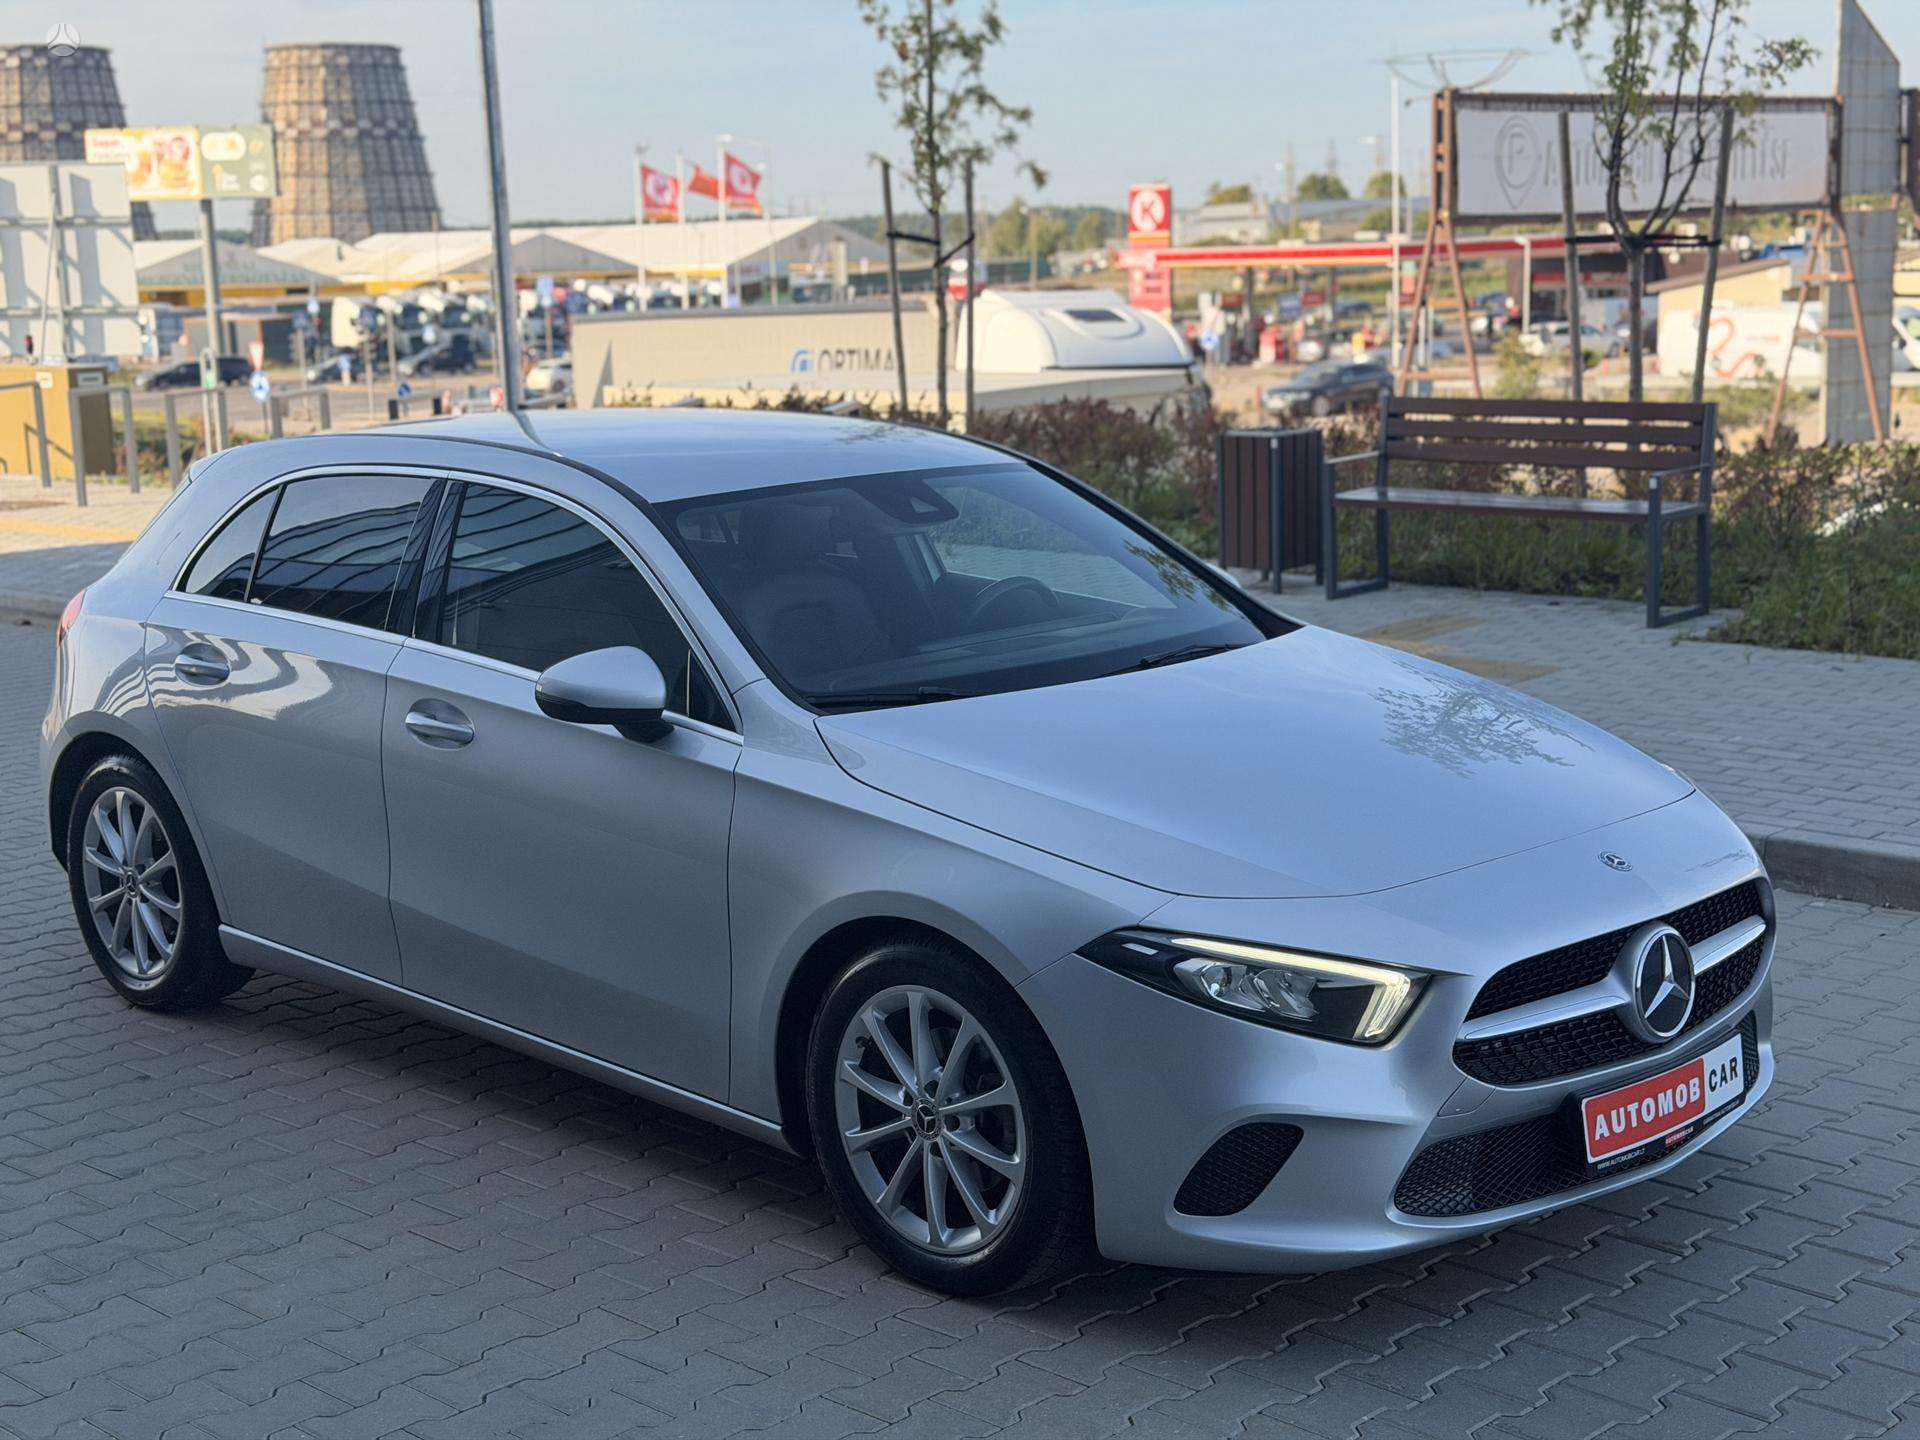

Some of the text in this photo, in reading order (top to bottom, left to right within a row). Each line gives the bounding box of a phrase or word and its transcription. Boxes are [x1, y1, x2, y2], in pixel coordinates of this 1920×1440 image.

[817, 347, 895, 372] OPTIMA
[1595, 1077, 1700, 1141] AUTOMOB
[1708, 1056, 1739, 1093] CAR
